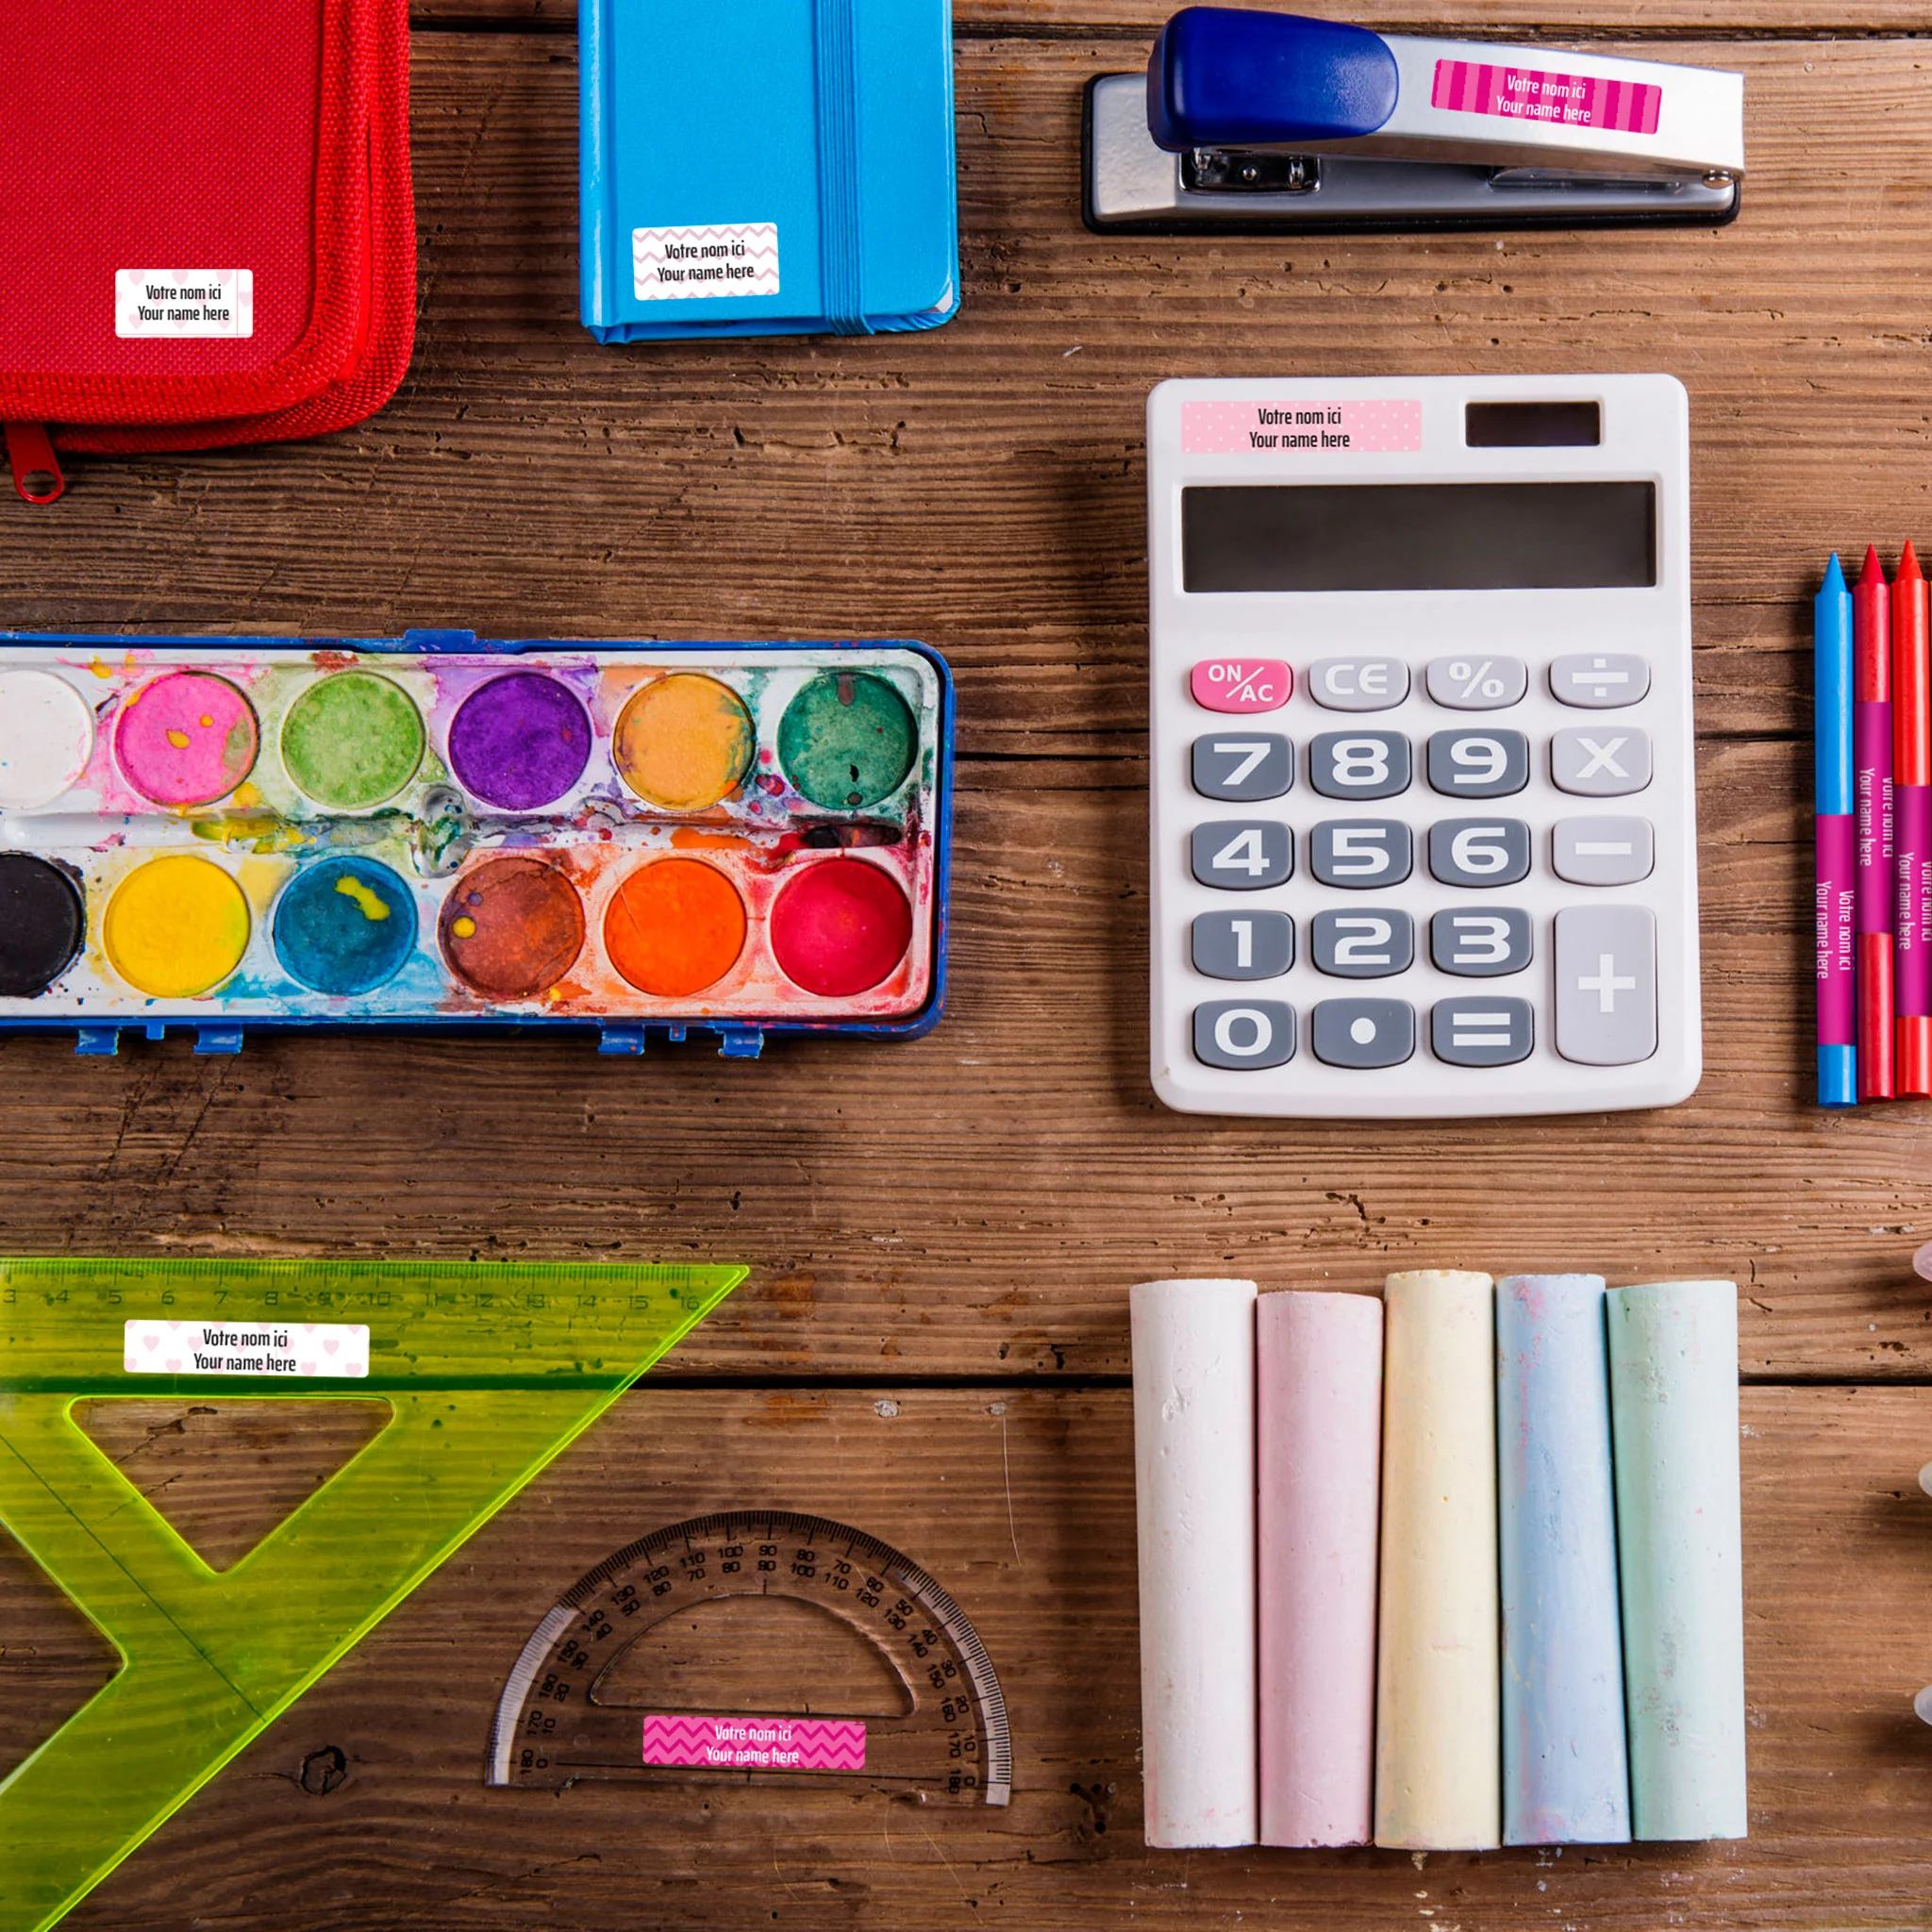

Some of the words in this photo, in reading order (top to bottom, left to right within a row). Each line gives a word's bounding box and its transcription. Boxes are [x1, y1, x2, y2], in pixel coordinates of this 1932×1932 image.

[1507, 75, 1539, 93] Votre
[1542, 83, 1569, 97] nom
[1572, 82, 1586, 99] ici
[1497, 95, 1524, 113] Your
[1526, 104, 1560, 118] name
[1564, 104, 1591, 122] here
[665, 244, 697, 258] Votre
[701, 245, 728, 258] nom
[732, 240, 744, 256] ici
[658, 267, 685, 282] Your
[689, 267, 723, 279] name
[726, 263, 754, 278] here
[146, 285, 176, 299] Votre
[180, 288, 205, 299] nom
[209, 284, 221, 299] ici
[138, 306, 164, 320] Your
[168, 309, 200, 320] name
[204, 305, 229, 320] here
[1258, 408, 1291, 425] Votre
[1296, 412, 1324, 424] nom
[1328, 408, 1341, 424] ici
[1249, 432, 1278, 447] Your
[1282, 435, 1317, 447] name
[1322, 430, 1350, 447] here
[1325, 664, 1388, 694] CE
[1214, 742, 1271, 785] 7
[1332, 739, 1390, 786] 8
[1450, 737, 1507, 784] 9
[1859, 768, 1875, 796] Your
[1860, 799, 1872, 835] name
[1883, 813, 1892, 841] nom
[1212, 829, 1270, 875] 4
[1332, 828, 1390, 874] 5
[1451, 827, 1508, 874] 6
[1860, 839, 1876, 866] here
[1899, 852, 1914, 880] Your
[1816, 881, 1832, 909] Your
[1899, 883, 1910, 919] name
[1840, 891, 1855, 922] Votre
[1922, 898, 1932, 924] nom
[1816, 913, 1828, 947] name
[1840, 926, 1851, 953] nom
[1899, 922, 1915, 950] here
[1231, 921, 1252, 967] 1
[1335, 918, 1391, 964] 2
[1453, 917, 1510, 964] 3
[1817, 951, 1833, 978] here
[1840, 957, 1855, 970] ici
[1215, 1008, 1272, 1056] 0
[3, 1290, 16, 1303] 3
[56, 1290, 71, 1303] 4
[108, 1291, 122, 1304] 5
[162, 1291, 175, 1305] 6
[213, 1291, 227, 1305] 7
[265, 1291, 278, 1305] 8
[368, 1292, 390, 1306] 10
[475, 1293, 492, 1307] 12
[527, 1294, 544, 1307] 13
[577, 1295, 596, 1307] 14
[629, 1296, 648, 1309] 15
[681, 1296, 700, 1309] 16
[204, 1329, 238, 1346] Votre
[242, 1334, 270, 1346] nom
[274, 1330, 287, 1347] ici
[194, 1354, 224, 1369] Your
[226, 1357, 262, 1370] name
[267, 1354, 296, 1371] here
[679, 1552, 706, 1568] 110
[718, 1545, 743, 1558] 100
[759, 1545, 777, 1556] 90
[796, 1549, 814, 1561] 80
[643, 1566, 670, 1583] 120
[687, 1568, 706, 1582] 70
[722, 1561, 741, 1574] 80
[758, 1560, 775, 1571] 90
[790, 1563, 815, 1577] 100
[833, 1559, 851, 1574] 70
[653, 1581, 672, 1596] 60
[824, 1573, 848, 1590] 110
[866, 1576, 884, 1592] 60
[611, 1585, 635, 1605] 130
[856, 1588, 879, 1607] 120
[622, 1599, 641, 1616] 50
[895, 1599, 913, 1616] 50
[582, 1609, 606, 1631] 140
[884, 1608, 906, 1630] 130
[596, 1623, 612, 1641] 40
[923, 1629, 938, 1645] 40
[908, 1634, 928, 1657] 140
[927, 1664, 944, 1689] 150
[941, 1659, 957, 1677] 30
[554, 1683, 570, 1702] 20
[941, 1697, 956, 1723] 160
[956, 1695, 969, 1713] 20
[526, 1710, 542, 1735] 170
[541, 1718, 557, 1734] 10
[715, 1725, 745, 1740] Votre
[749, 1729, 775, 1740] nom
[778, 1725, 791, 1740] ici
[949, 1732, 961, 1757] 170
[964, 1735, 975, 1752] 10
[521, 1749, 533, 1774] 180
[536, 1758, 548, 1768] 0
[707, 1747, 733, 1761] Your
[736, 1750, 769, 1763] name
[773, 1748, 798, 1763] here
[949, 1770, 960, 1794] 180
[964, 1776, 975, 1787] 0
